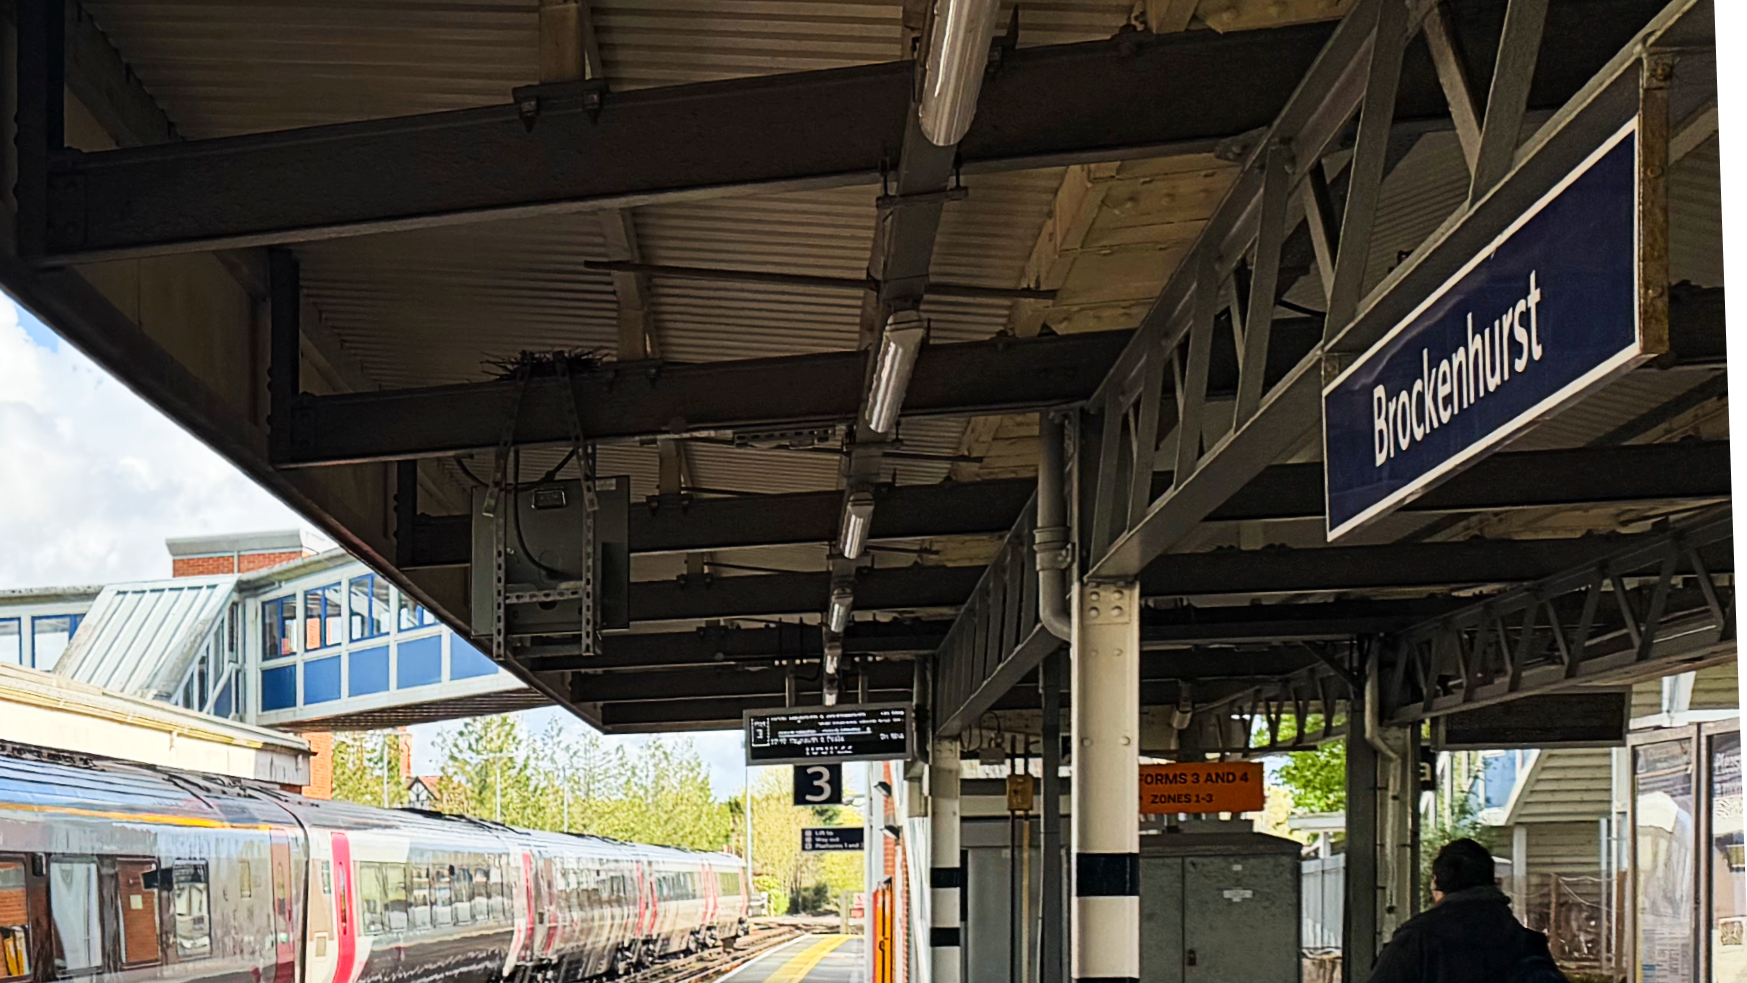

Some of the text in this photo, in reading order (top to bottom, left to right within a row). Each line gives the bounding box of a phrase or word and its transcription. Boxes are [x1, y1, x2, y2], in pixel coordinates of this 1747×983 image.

[1373, 269, 1543, 468] Brockenhurst
[805, 766, 832, 802] 3
[1191, 773, 1200, 784] 3
[1204, 772, 1236, 784] AND
[1240, 772, 1250, 784] 4
[1150, 793, 1214, 804] ZONES 1-3
